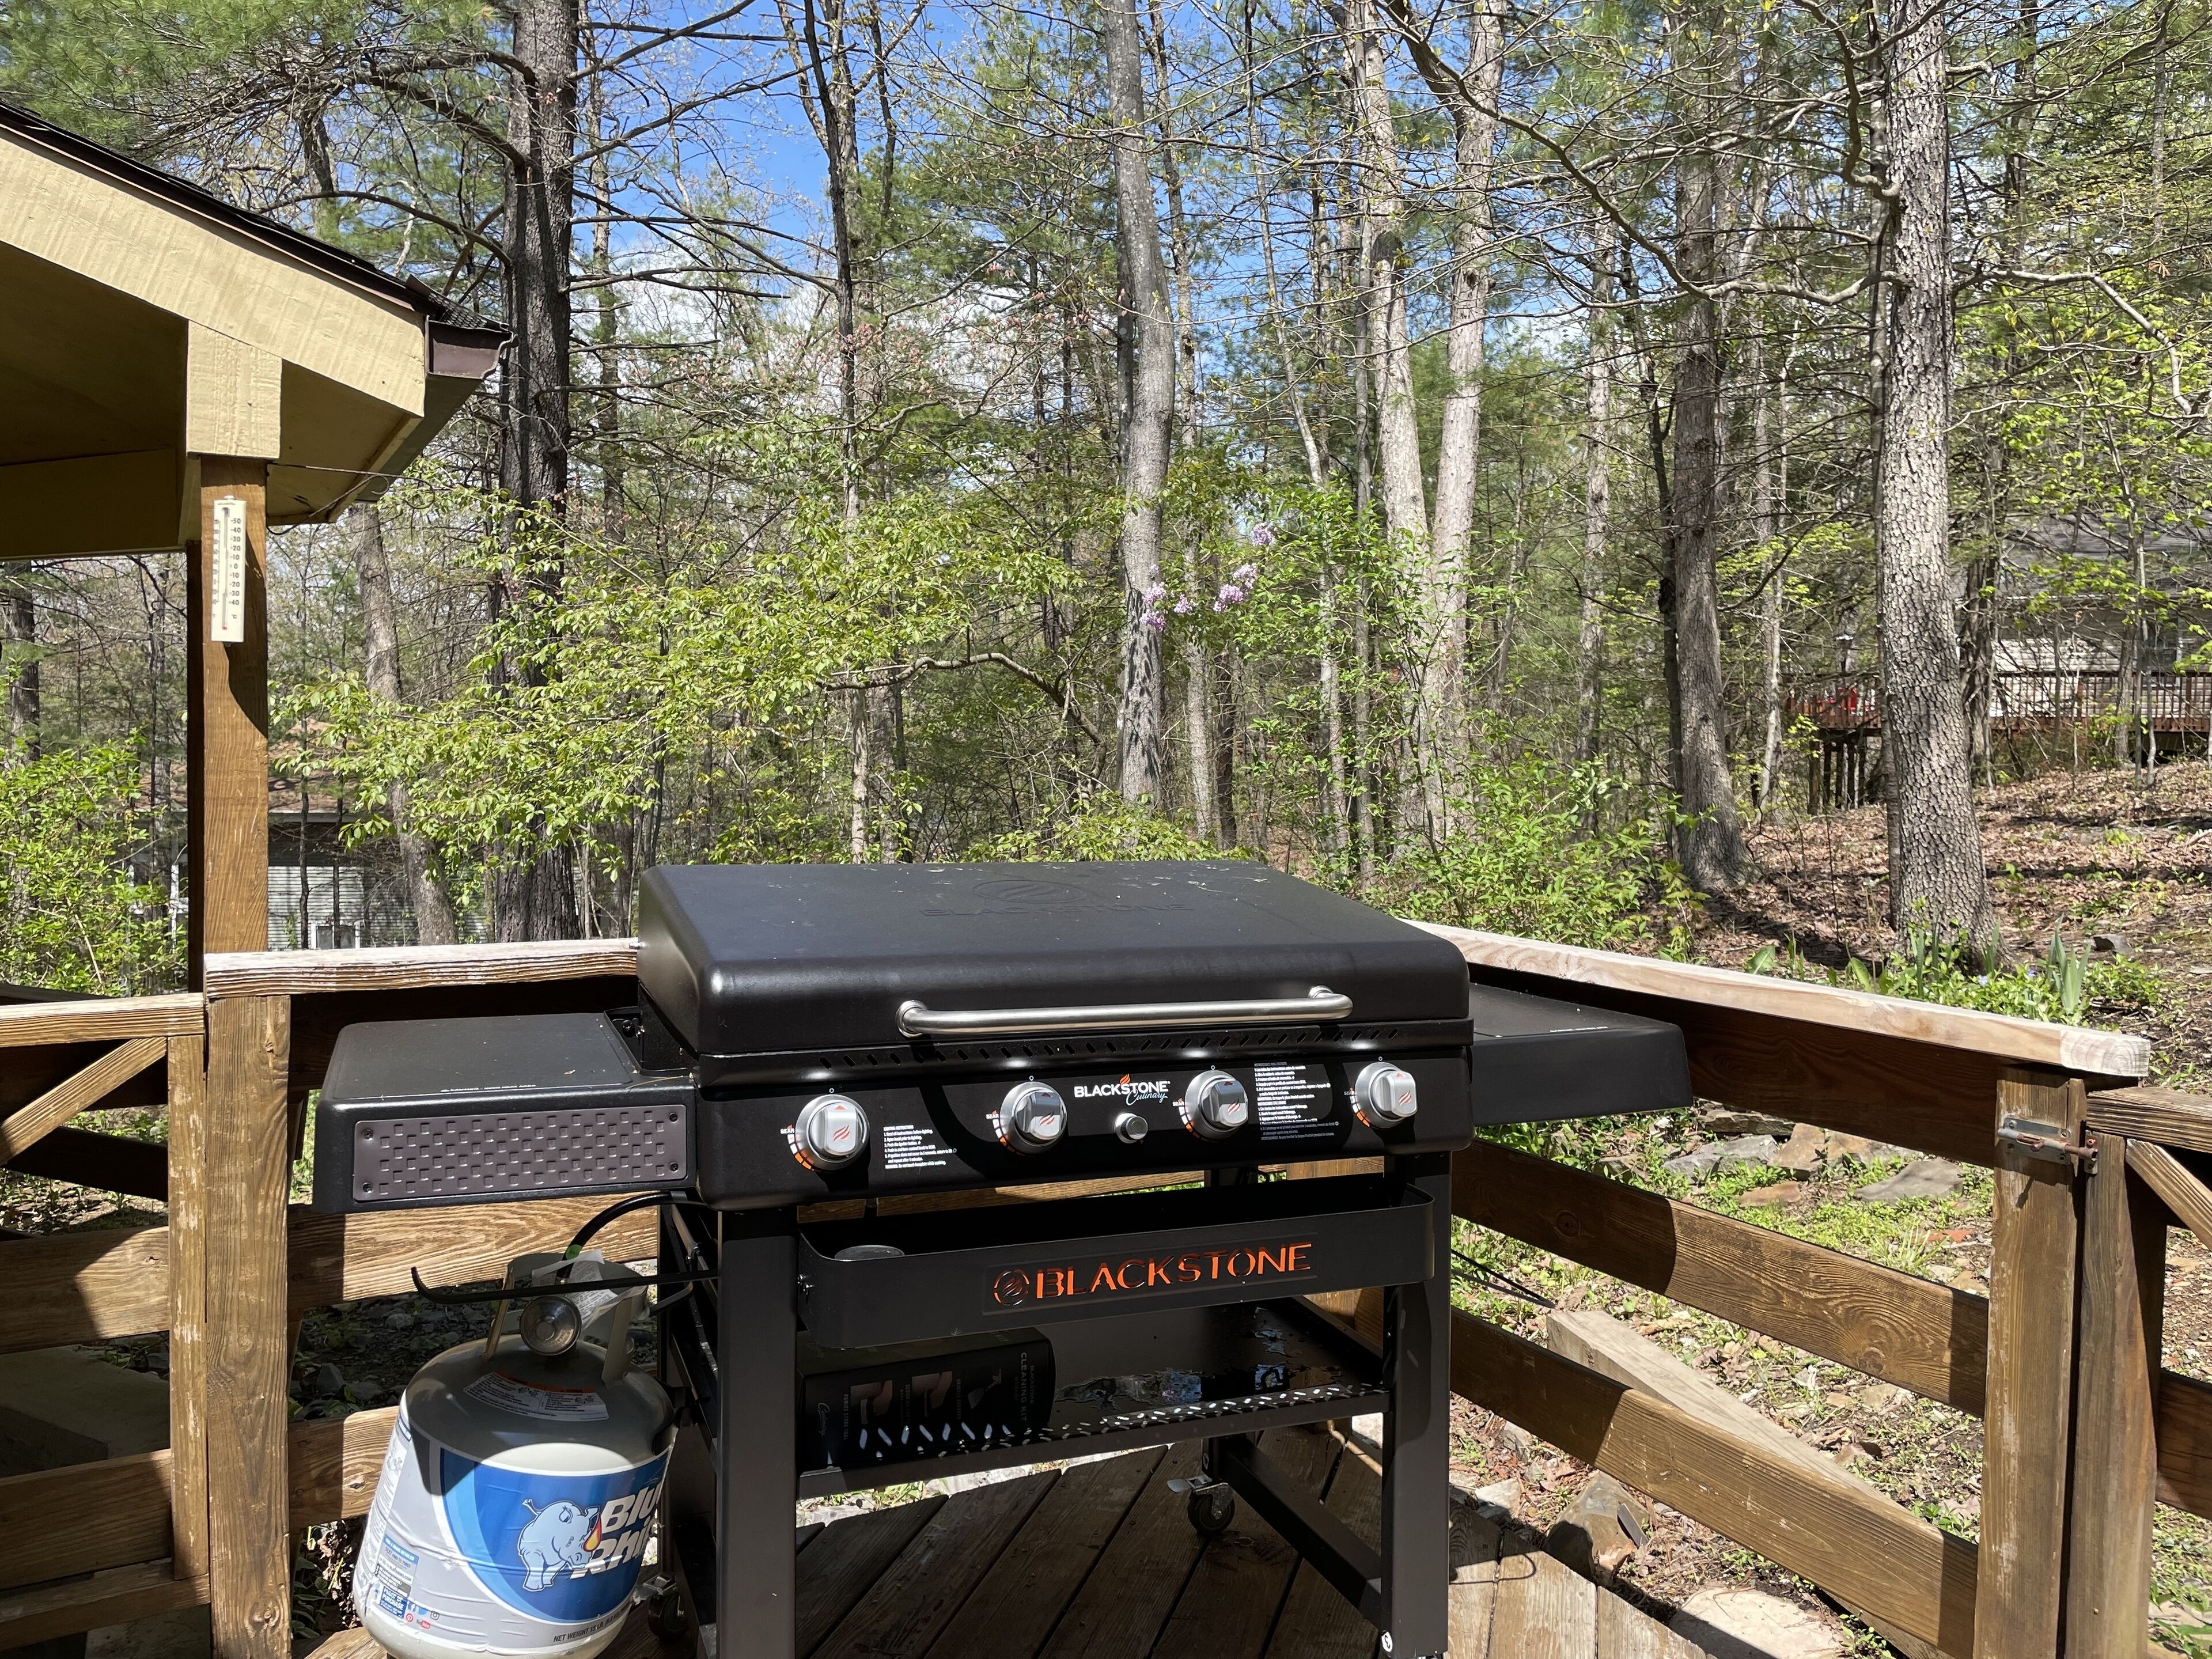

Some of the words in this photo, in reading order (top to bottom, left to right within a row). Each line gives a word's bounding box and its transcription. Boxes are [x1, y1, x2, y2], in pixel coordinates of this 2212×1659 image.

[1074, 1081, 1168, 1097] BLACKSTONE
[1126, 1089, 1168, 1105] Culinary
[1036, 1241, 1312, 1299] BLACKSTONE
[601, 1483, 661, 1533] Blu
[570, 1516, 655, 1580] Rhi
[382, 1594, 404, 1610] PURCHASE
[553, 1634, 566, 1642] NET
[567, 1627, 589, 1639] WEIGHT
